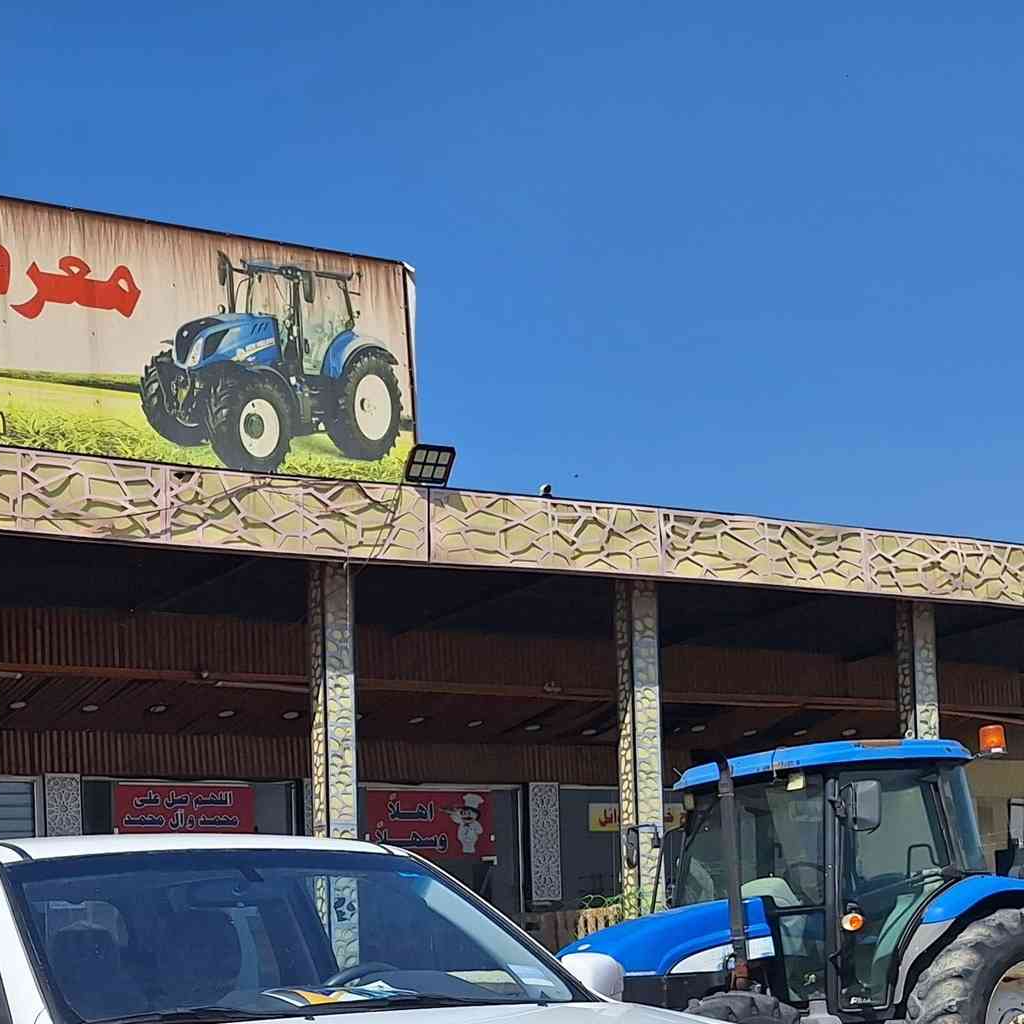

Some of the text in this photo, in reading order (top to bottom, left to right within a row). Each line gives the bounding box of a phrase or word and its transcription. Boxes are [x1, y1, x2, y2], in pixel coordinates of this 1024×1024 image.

[132, 790, 234, 811] اللهم صل على
[122, 813, 166, 829] محمد
[197, 814, 241, 829] محمد
